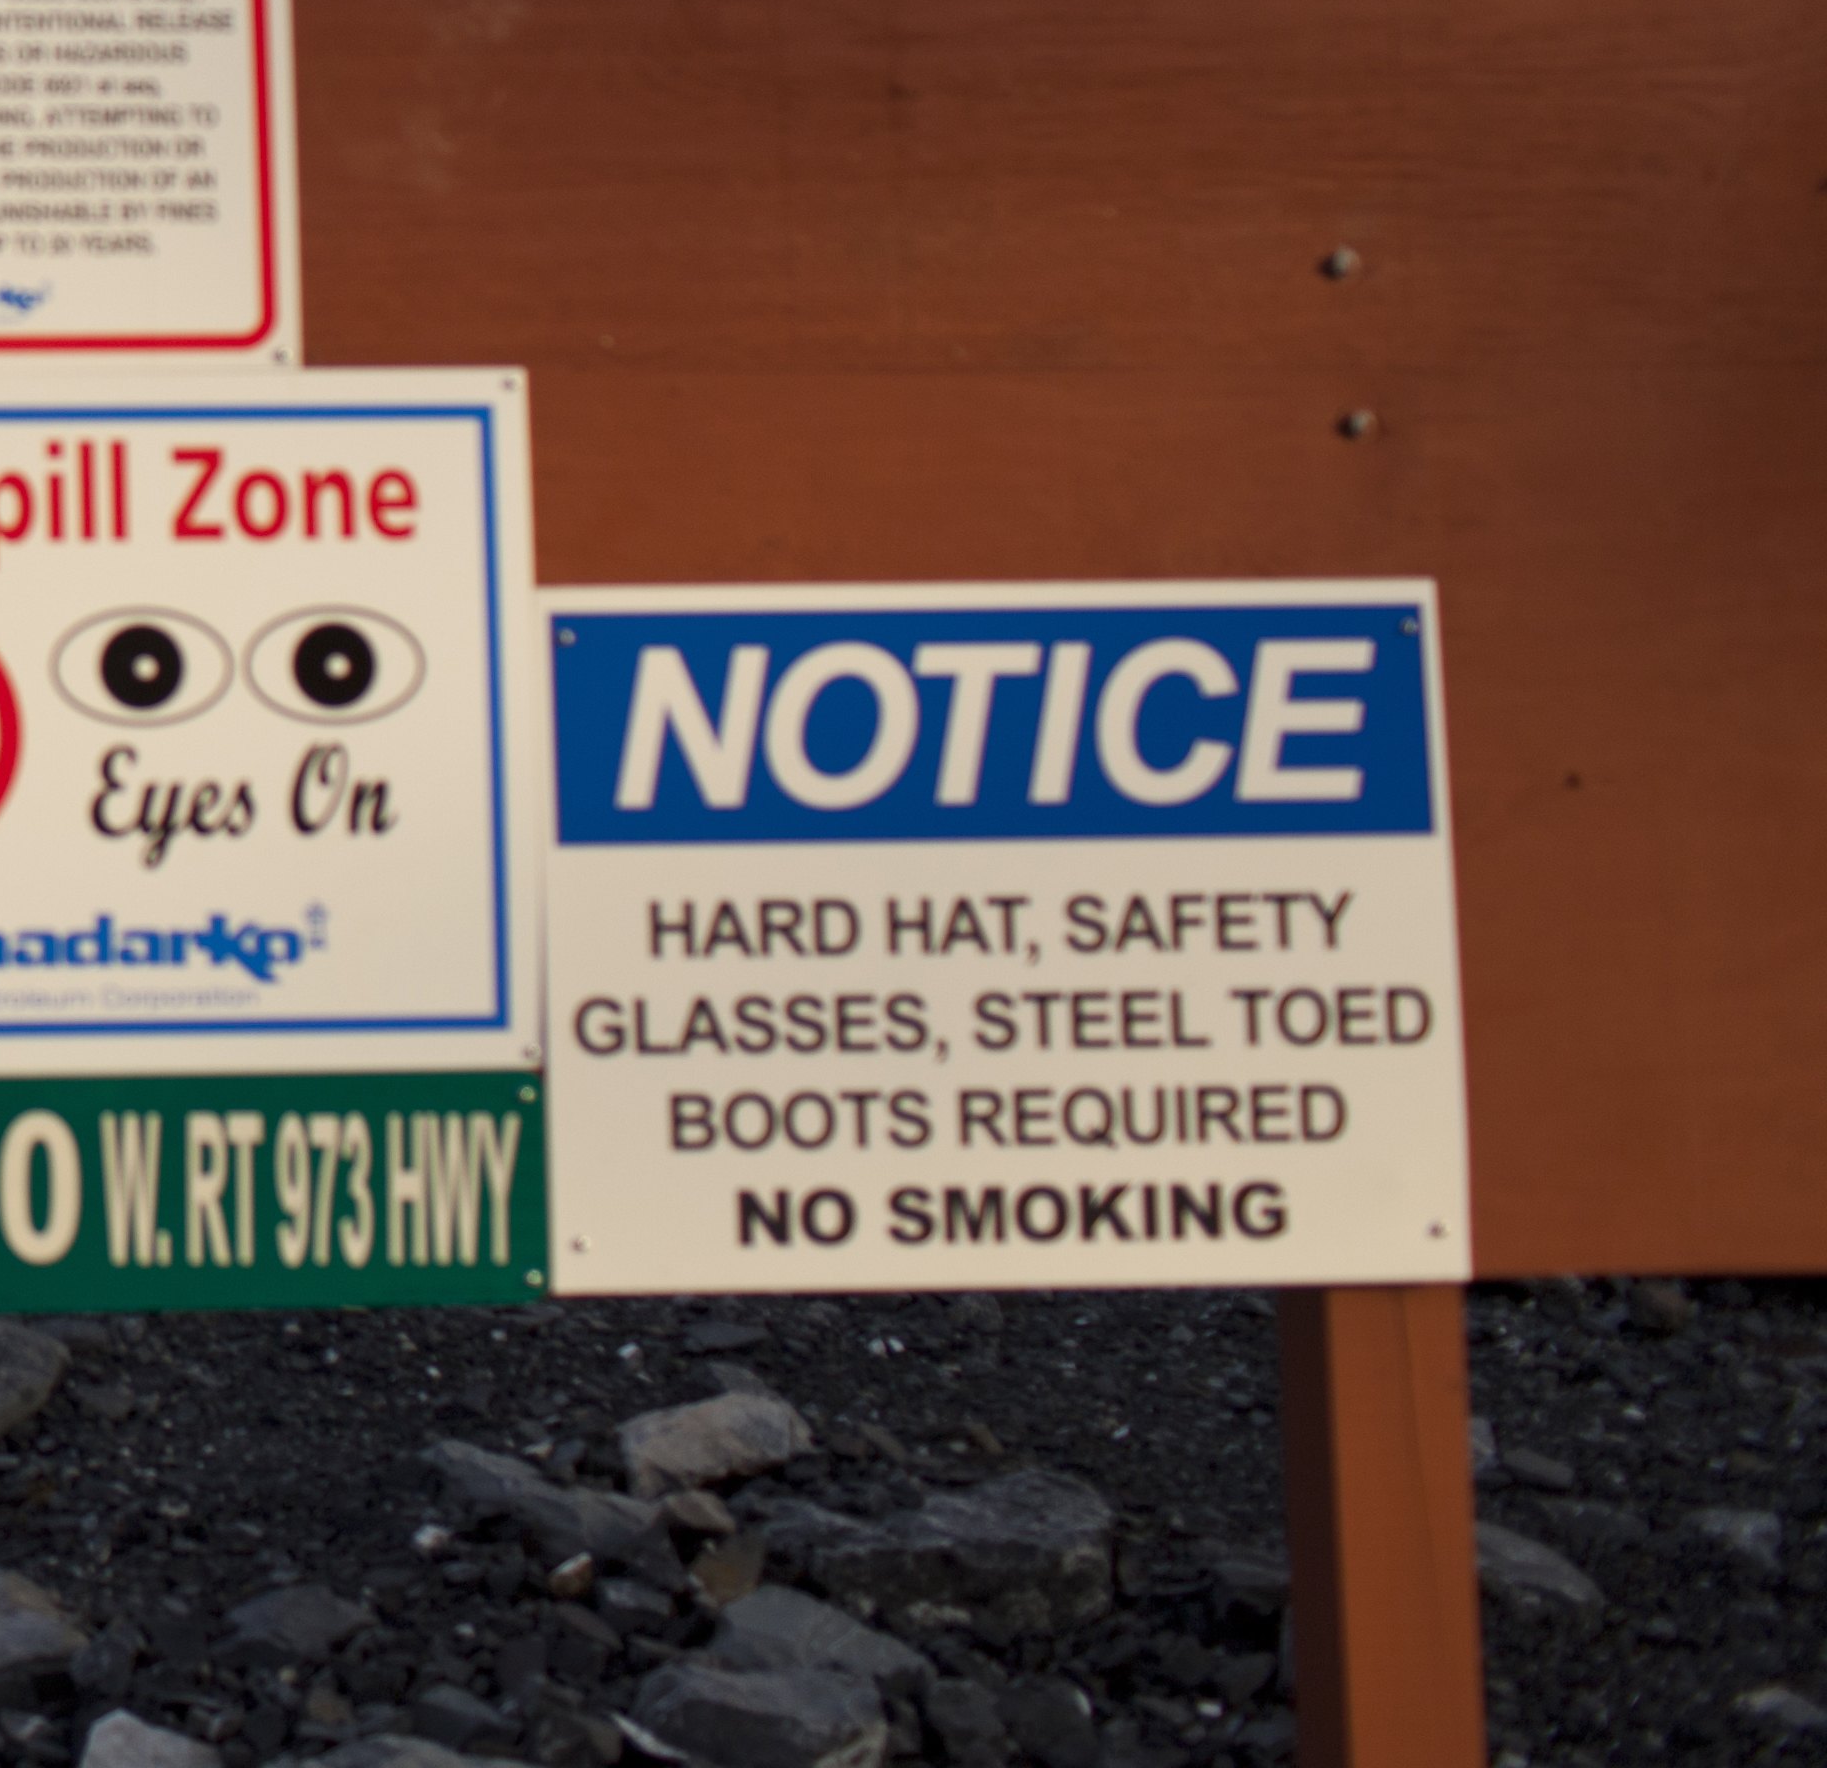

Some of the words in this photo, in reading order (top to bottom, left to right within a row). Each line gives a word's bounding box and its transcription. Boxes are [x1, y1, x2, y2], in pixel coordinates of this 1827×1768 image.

[172, 447, 418, 541] Zone
[613, 637, 1376, 810] NOTICE
[90, 745, 256, 869] Eyes
[290, 742, 395, 836] On
[649, 898, 860, 959] HARD
[887, 895, 1042, 963] HAT,
[1065, 892, 1354, 953] SAFETY
[573, 994, 949, 1062] GLASSES,
[973, 990, 1211, 1050] STEEL
[1232, 987, 1433, 1047] TOED
[669, 1090, 932, 1152] BOOTS
[959, 1084, 1346, 1150] REQUIRED
[100, 1109, 173, 1267] W.
[185, 1109, 264, 1267] RT
[276, 1109, 374, 1268] 973
[385, 1109, 522, 1267] HWY
[737, 1188, 856, 1247] NO
[888, 1181, 1289, 1245] SMOKING
